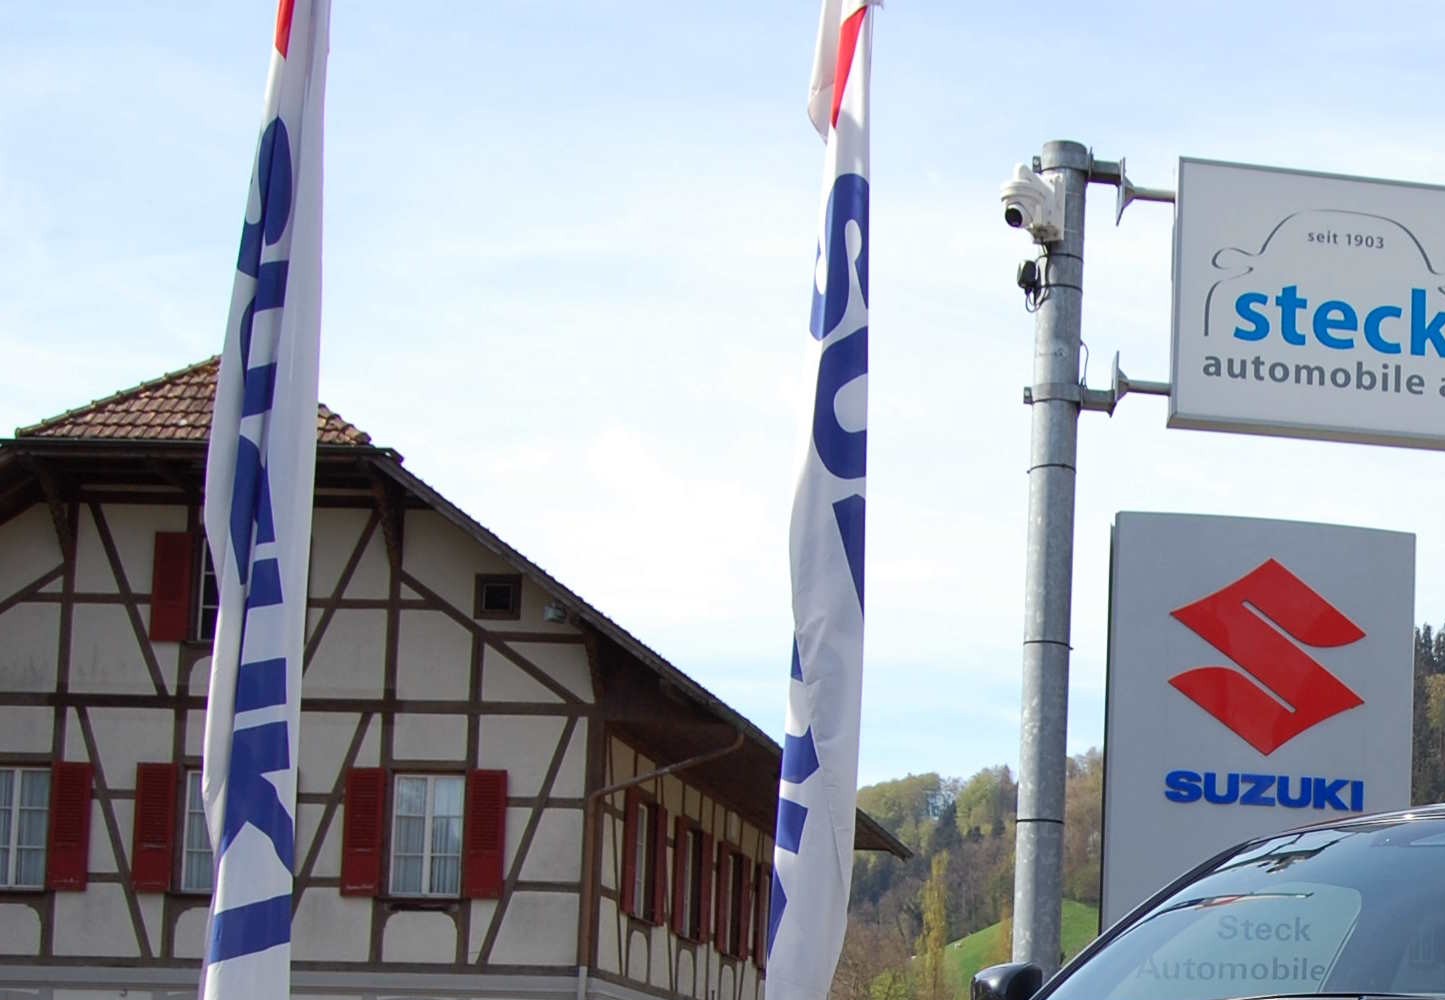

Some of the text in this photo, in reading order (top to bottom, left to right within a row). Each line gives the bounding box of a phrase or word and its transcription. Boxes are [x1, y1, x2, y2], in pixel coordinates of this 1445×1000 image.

[1307, 230, 1385, 249] seit 1903
[1202, 354, 1425, 396] automobile
[1163, 769, 1365, 813] SUZUKI
[1216, 914, 1313, 943] Steck
[1135, 956, 1326, 983] Automobile
